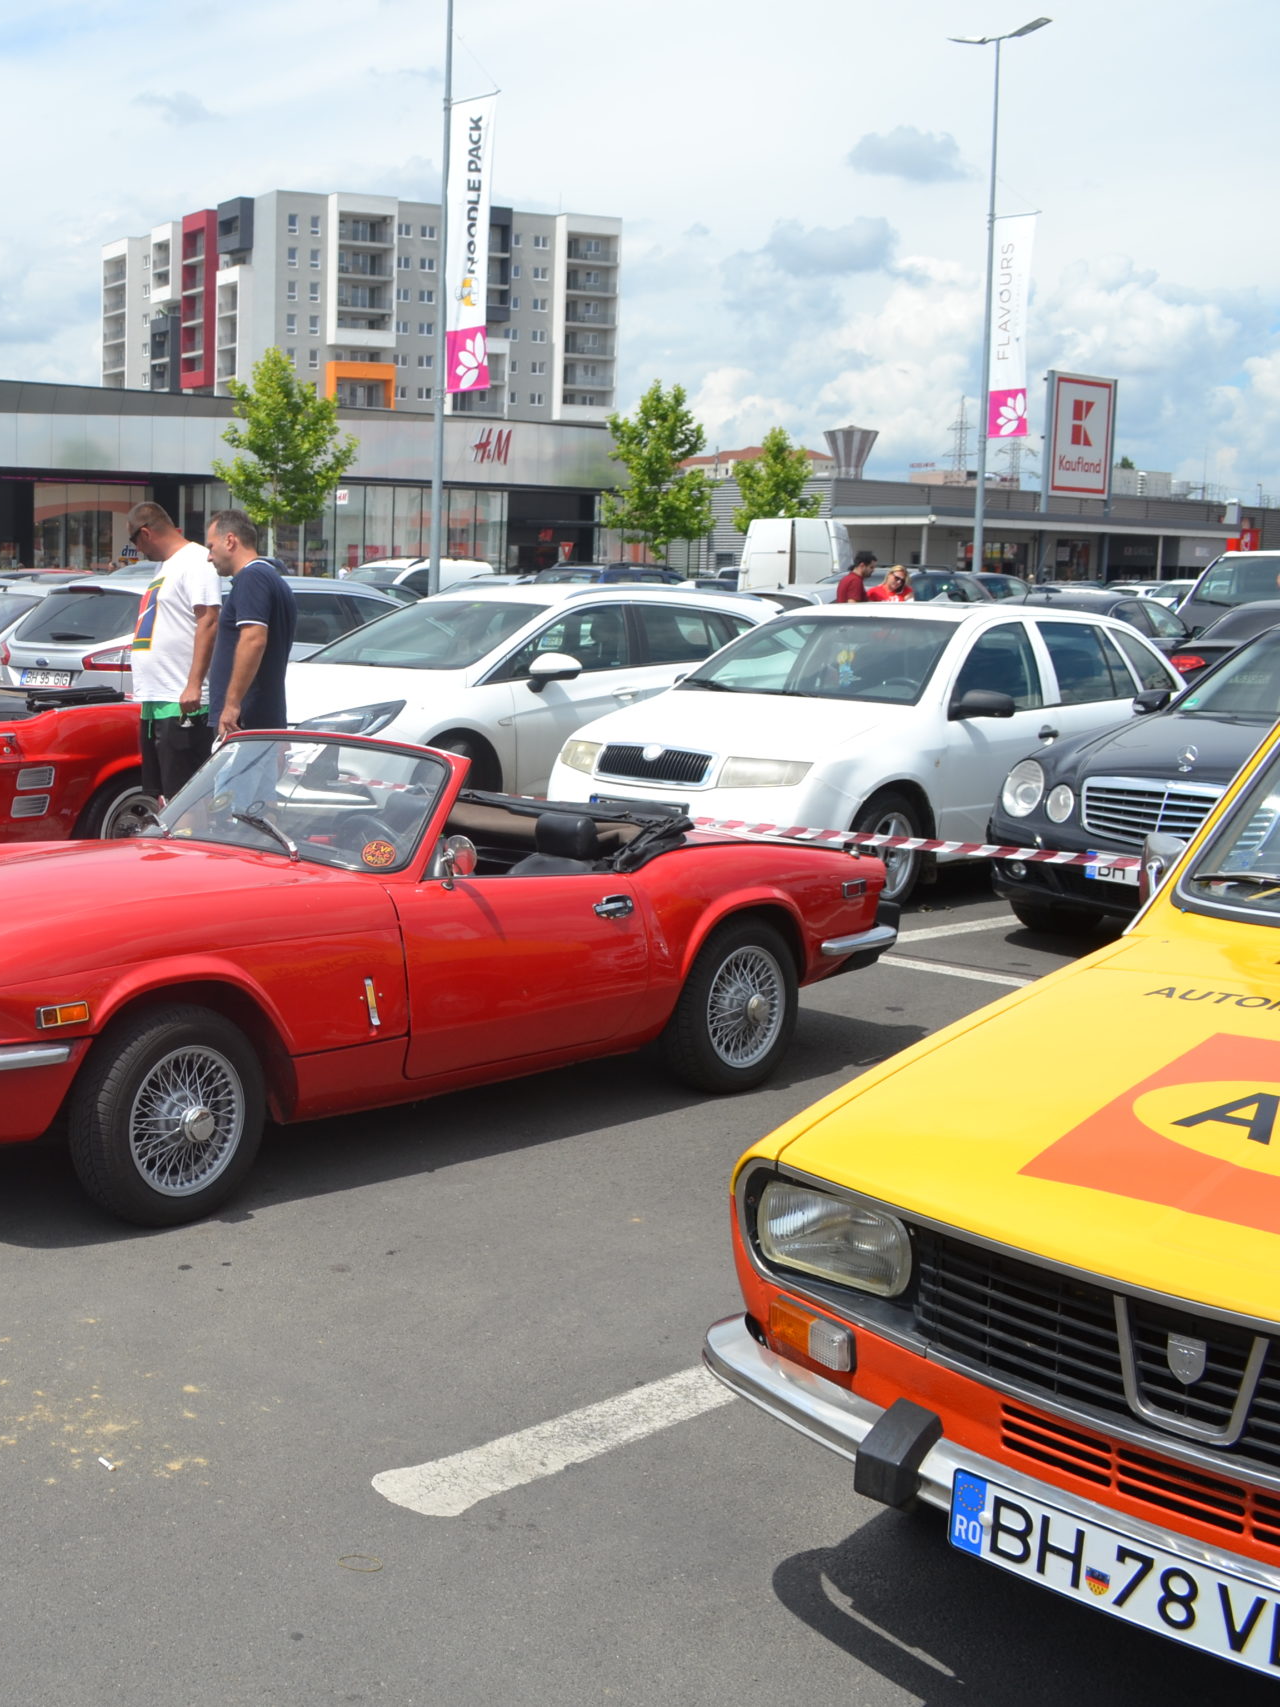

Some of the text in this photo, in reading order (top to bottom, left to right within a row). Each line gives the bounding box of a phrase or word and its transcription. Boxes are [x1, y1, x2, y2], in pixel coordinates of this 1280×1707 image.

[467, 115, 483, 173] PACK
[997, 243, 1015, 361] FLAVOURS
[472, 427, 512, 465] H&M
[1058, 454, 1102, 474] Kaufland
[25, 671, 70, 686] BH 95 GIG
[954, 1513, 981, 1545] RO
[989, 1494, 1086, 1591] BH
[1112, 1543, 1199, 1631] 78
